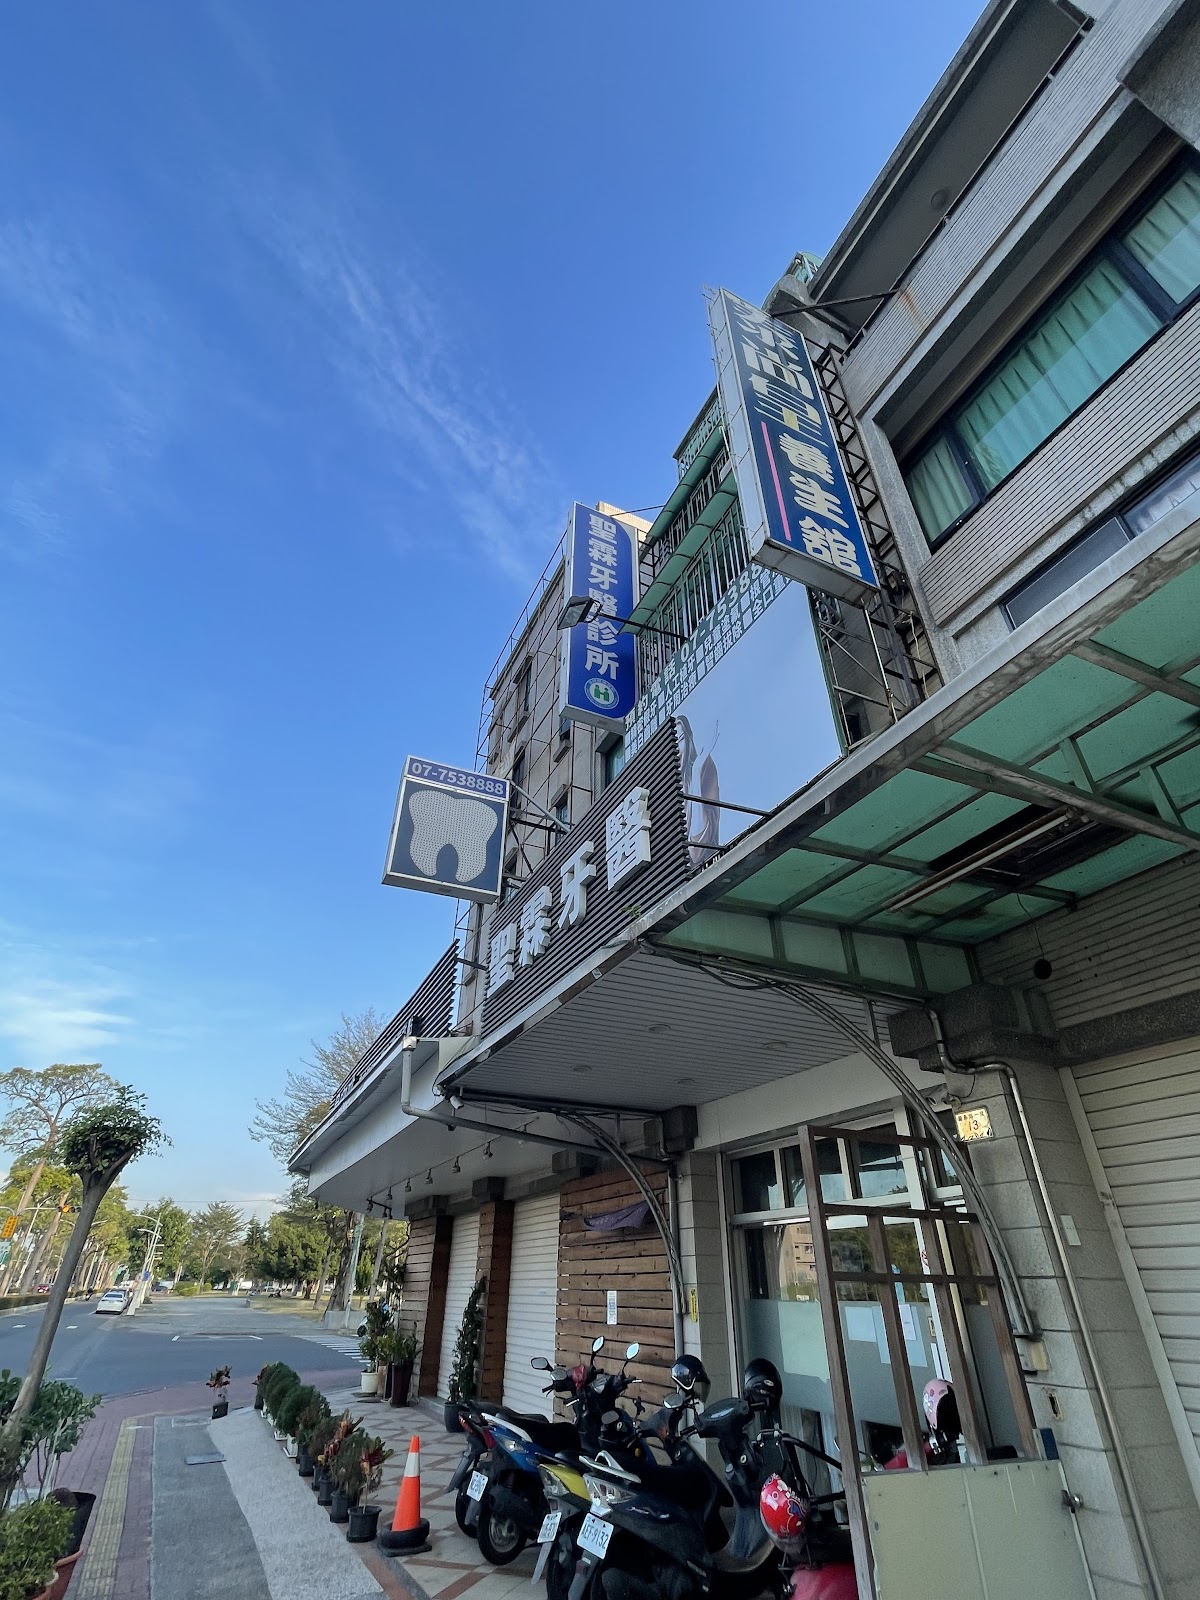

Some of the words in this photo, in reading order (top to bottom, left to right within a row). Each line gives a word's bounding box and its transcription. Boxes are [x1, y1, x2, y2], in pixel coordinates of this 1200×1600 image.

[665, 654, 696, 701] 人工植牙
[704, 602, 741, 653] 兒童塗氟
[666, 676, 697, 717] 牙周治療
[705, 620, 742, 671] 智齒拔除
[753, 574, 791, 620] 全口重
[625, 660, 676, 731] 預約電話
[411, 761, 504, 795] 07-7538888
[487, 786, 652, 1000] 聖霖牙醫
